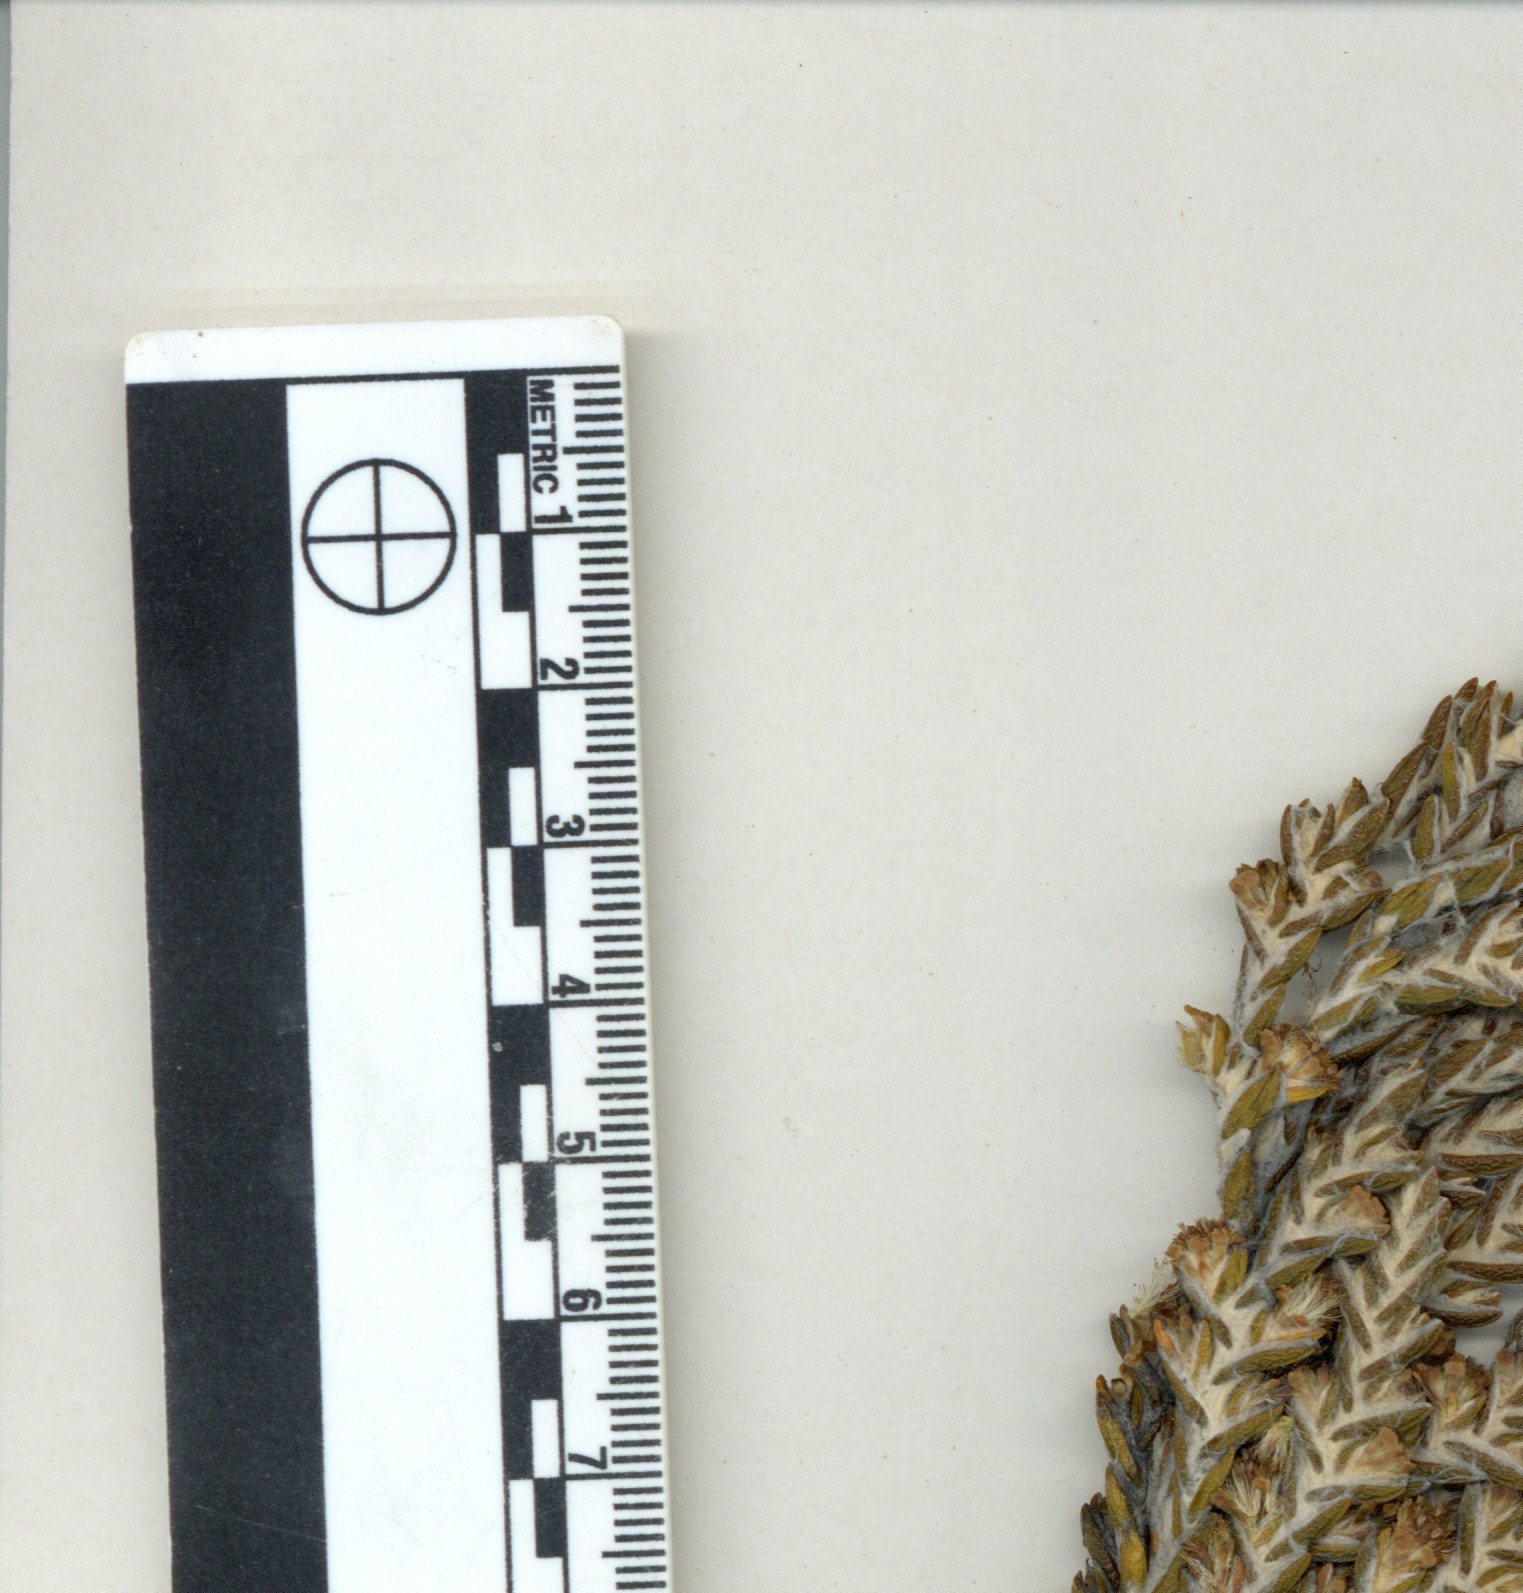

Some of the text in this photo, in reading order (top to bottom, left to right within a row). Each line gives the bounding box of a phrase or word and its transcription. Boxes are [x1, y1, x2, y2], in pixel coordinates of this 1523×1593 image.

[528, 378, 560, 495] METRIC
[534, 505, 573, 524] 1
[540, 657, 580, 681] 2
[546, 815, 586, 838] 3
[552, 974, 591, 998] 4
[557, 1131, 596, 1155] 5
[563, 1288, 602, 1313] 6
[569, 1446, 608, 1470] 7
